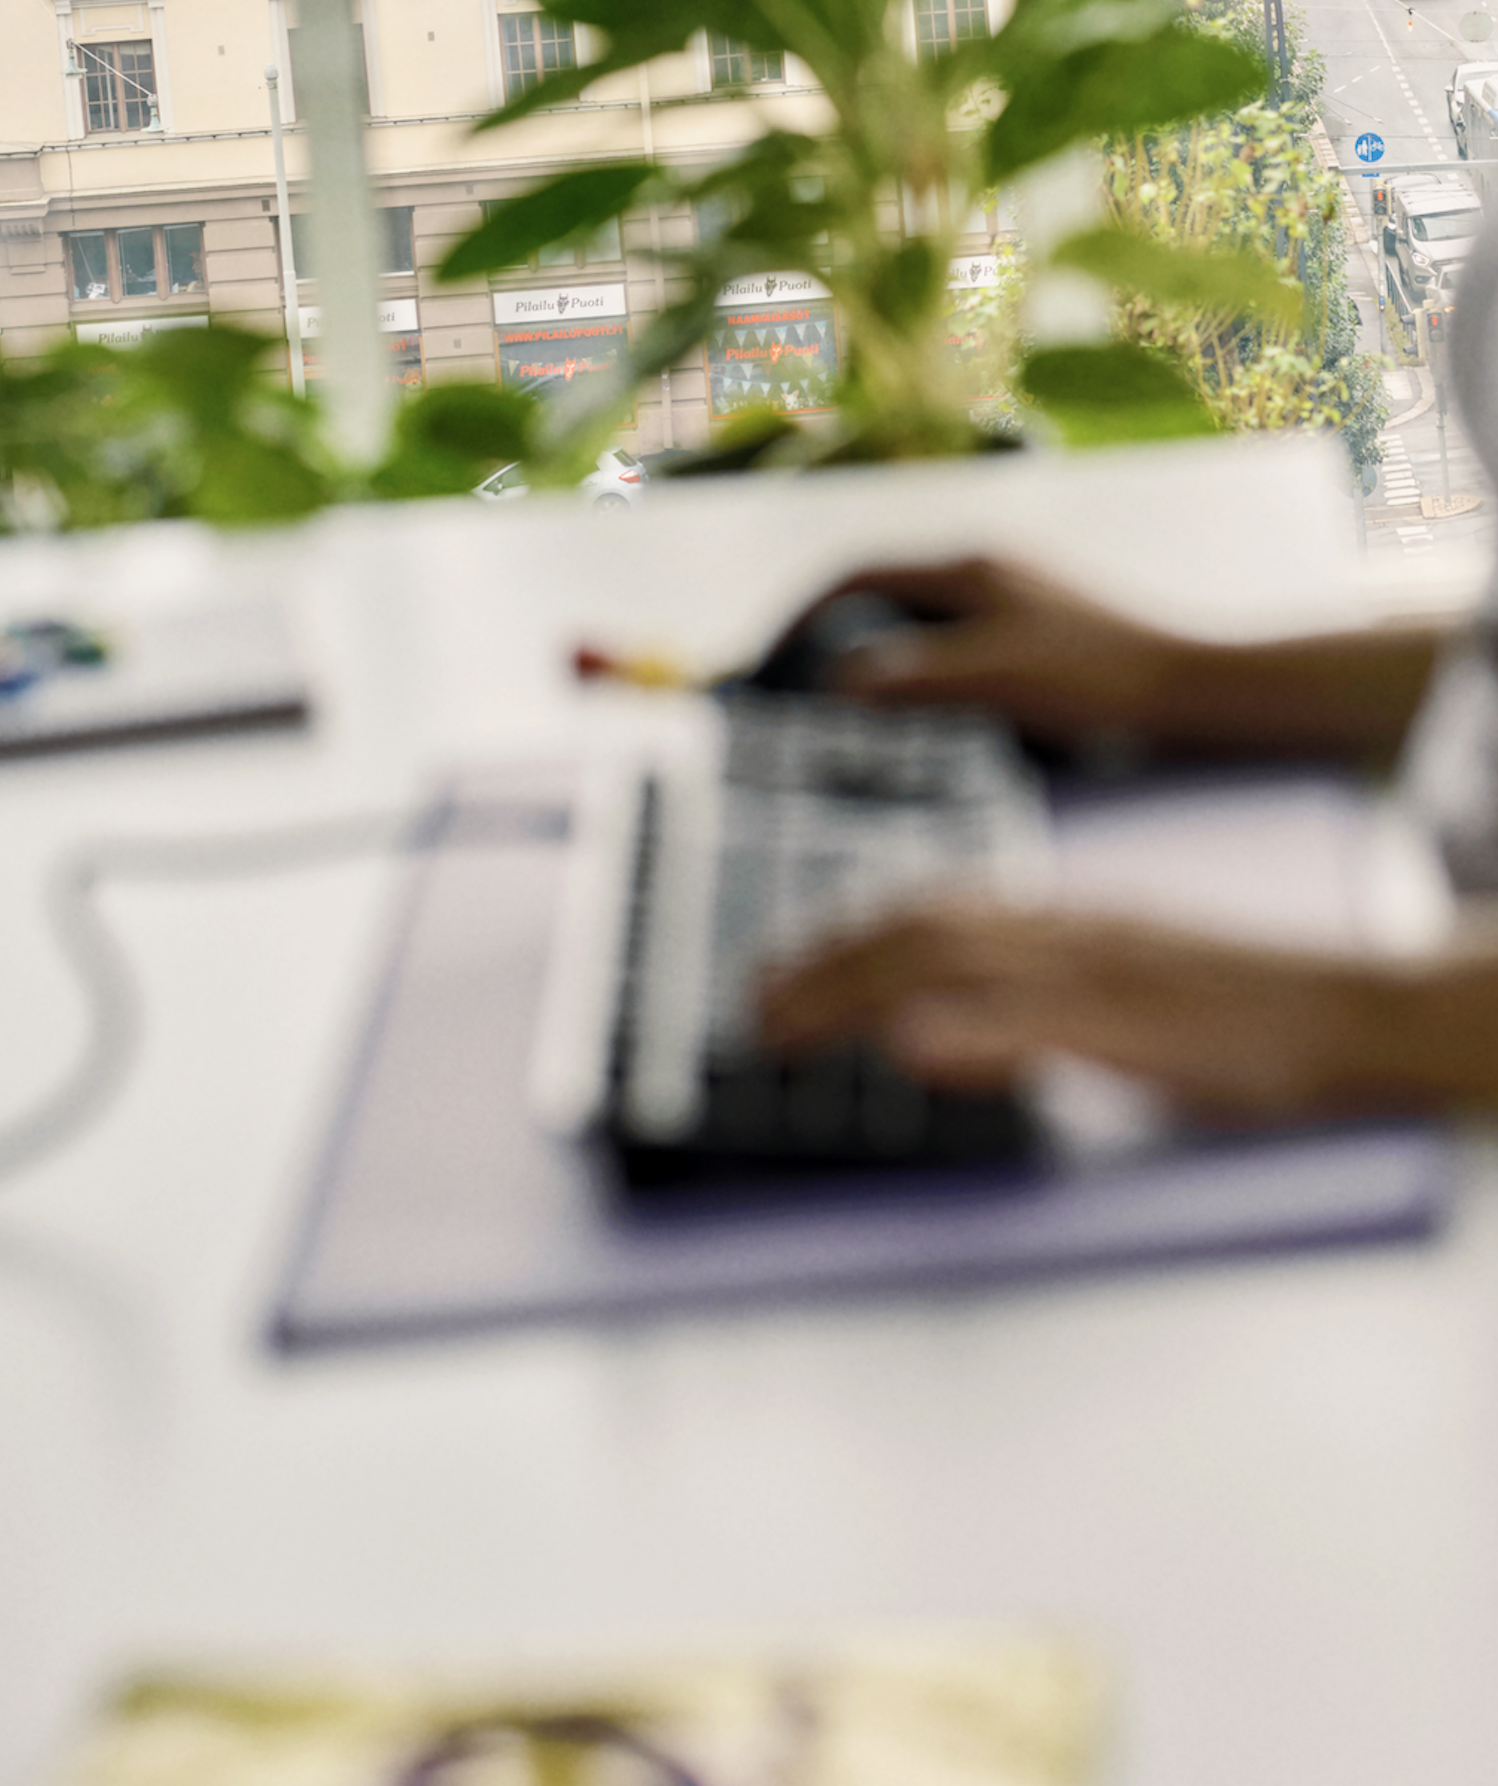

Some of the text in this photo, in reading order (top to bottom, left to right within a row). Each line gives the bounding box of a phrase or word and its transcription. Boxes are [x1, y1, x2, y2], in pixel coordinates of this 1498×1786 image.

[723, 279, 812, 296] Pilailu Puoti
[515, 296, 604, 313] Pilailu Puoti
[727, 310, 811, 326] NAAMIAISASUT
[98, 332, 139, 345] Pilailu
[503, 325, 623, 344] WWW.PILAILUPUOTI.FI
[725, 343, 820, 361] Pilailu Puoti
[519, 360, 614, 378] Pilailu Puoti
